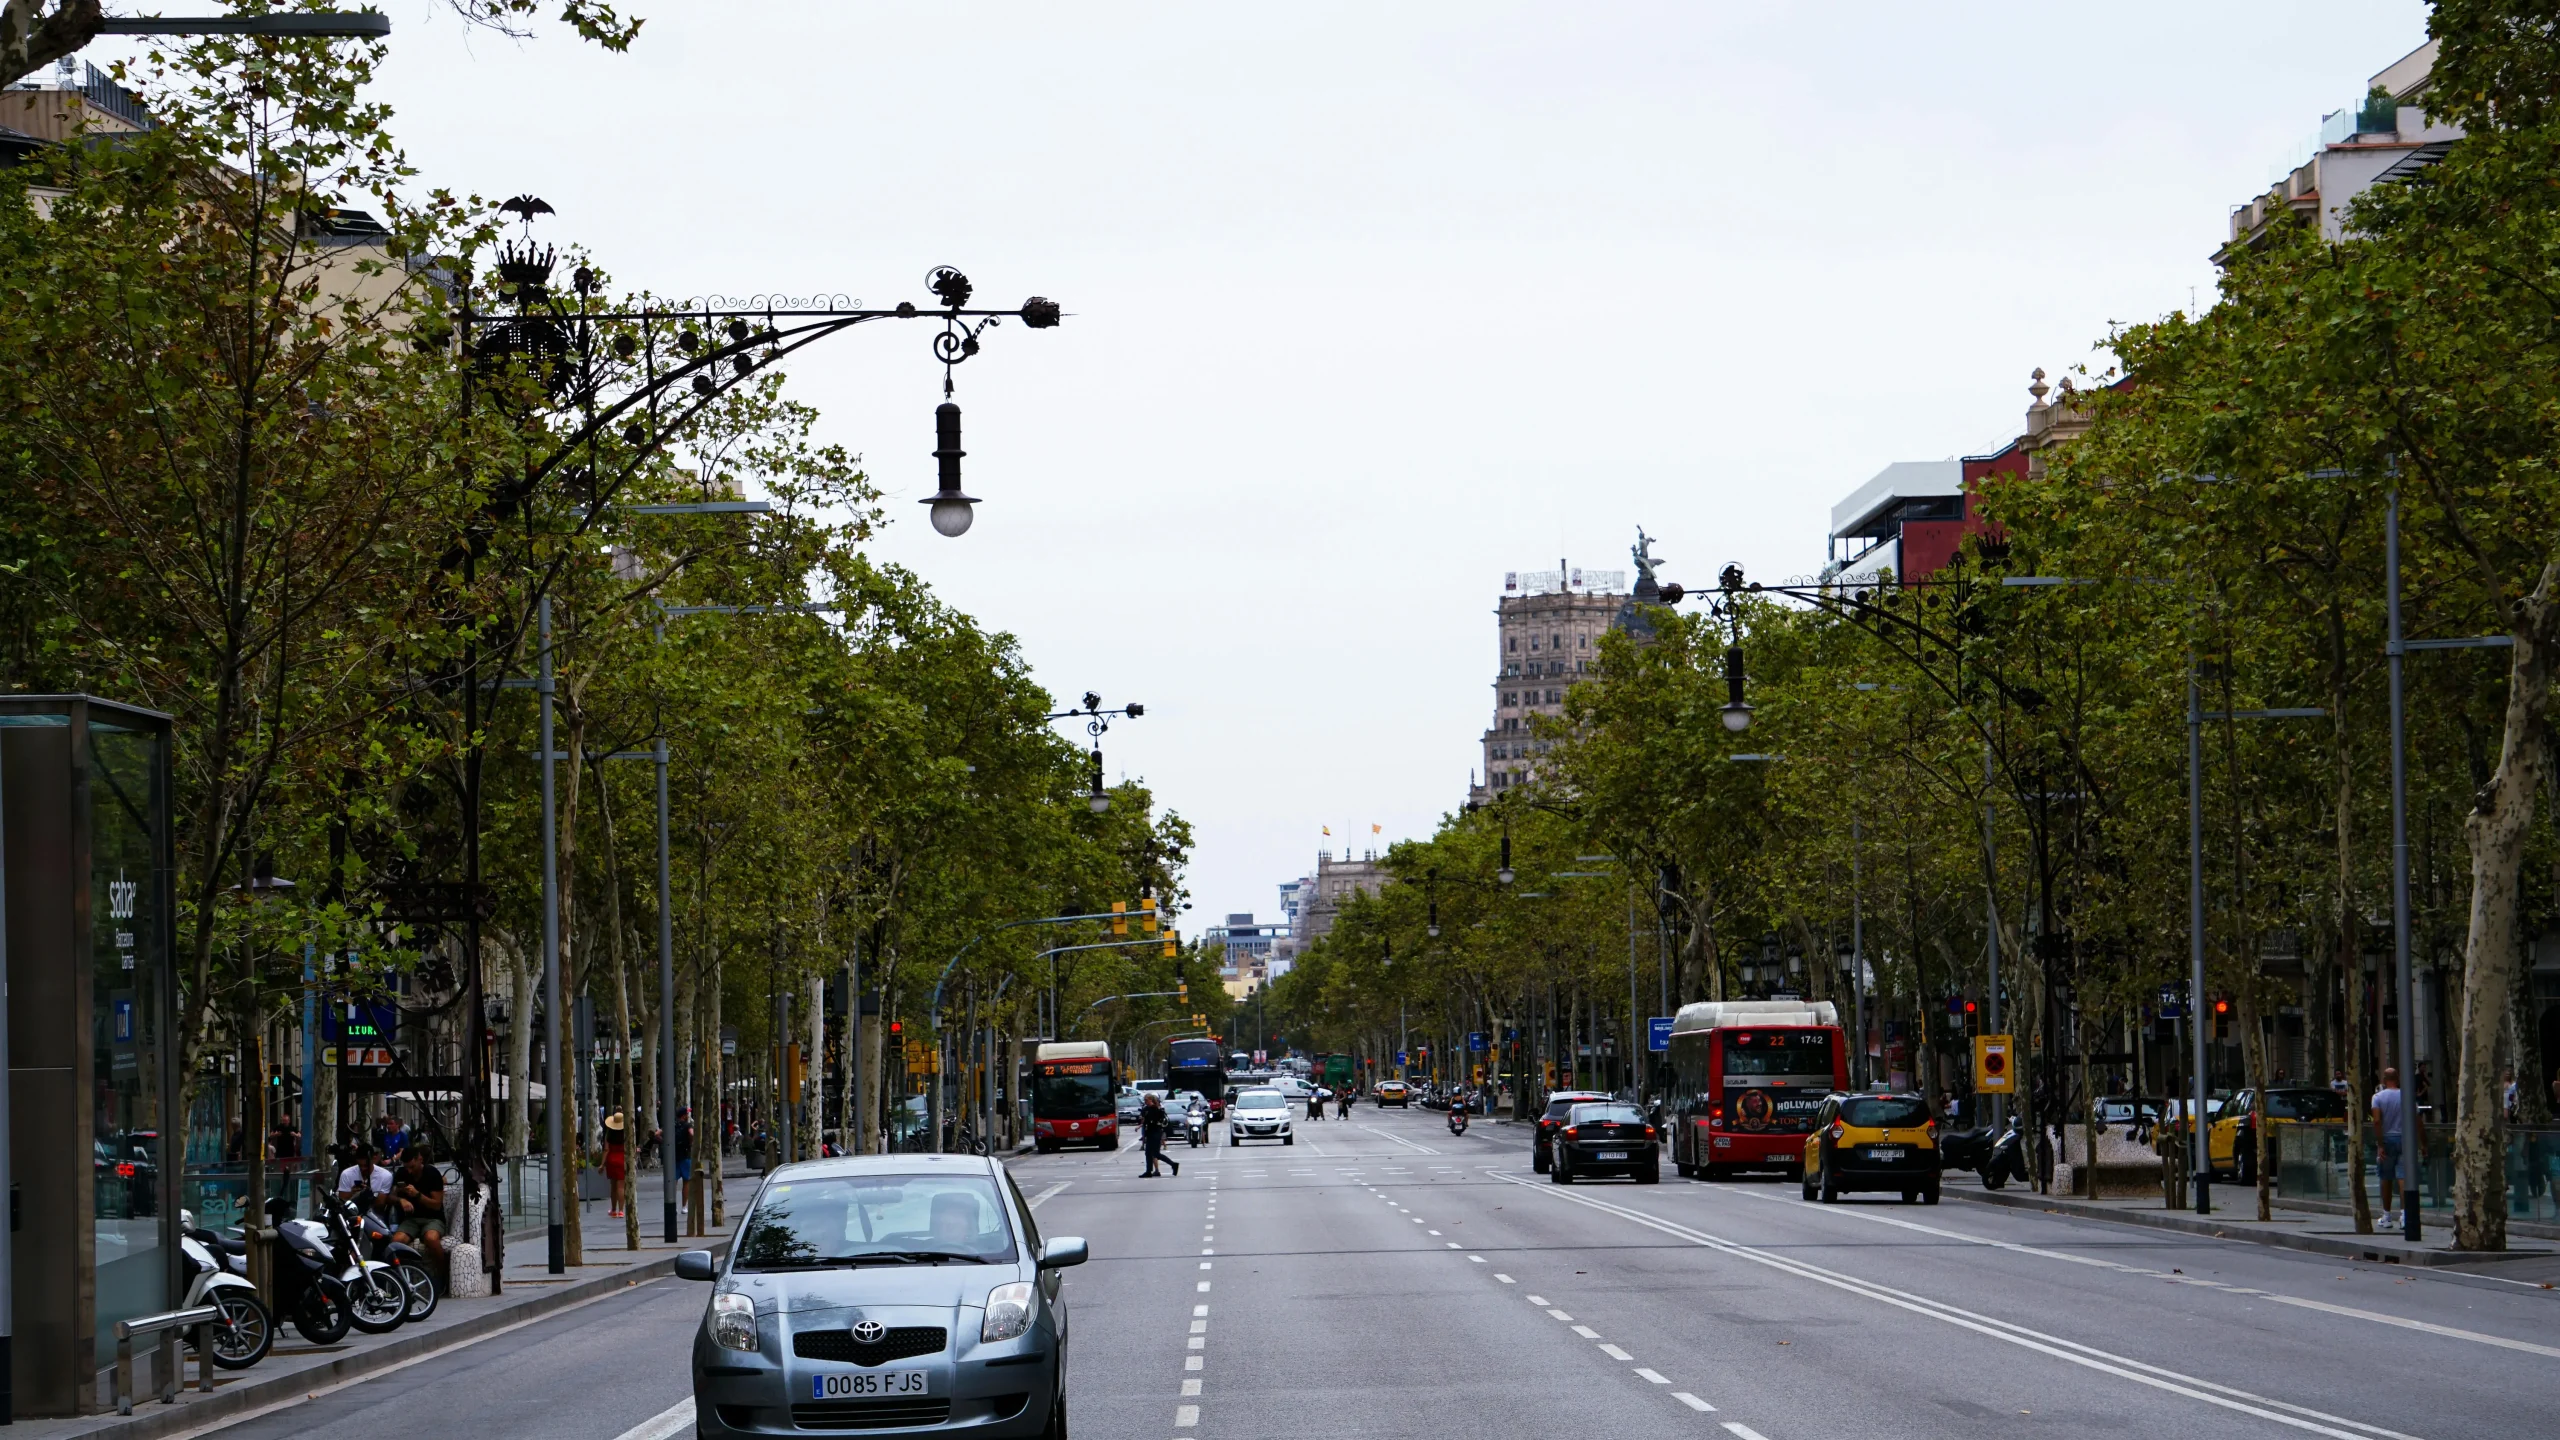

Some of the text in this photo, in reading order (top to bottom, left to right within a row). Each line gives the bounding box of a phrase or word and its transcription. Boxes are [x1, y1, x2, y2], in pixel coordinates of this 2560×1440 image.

[1770, 1036, 1784, 1046] 22
[1800, 1036, 1823, 1045] 1742
[1045, 1067, 1054, 1075] 22
[827, 1373, 922, 1395] 0085 FJS
